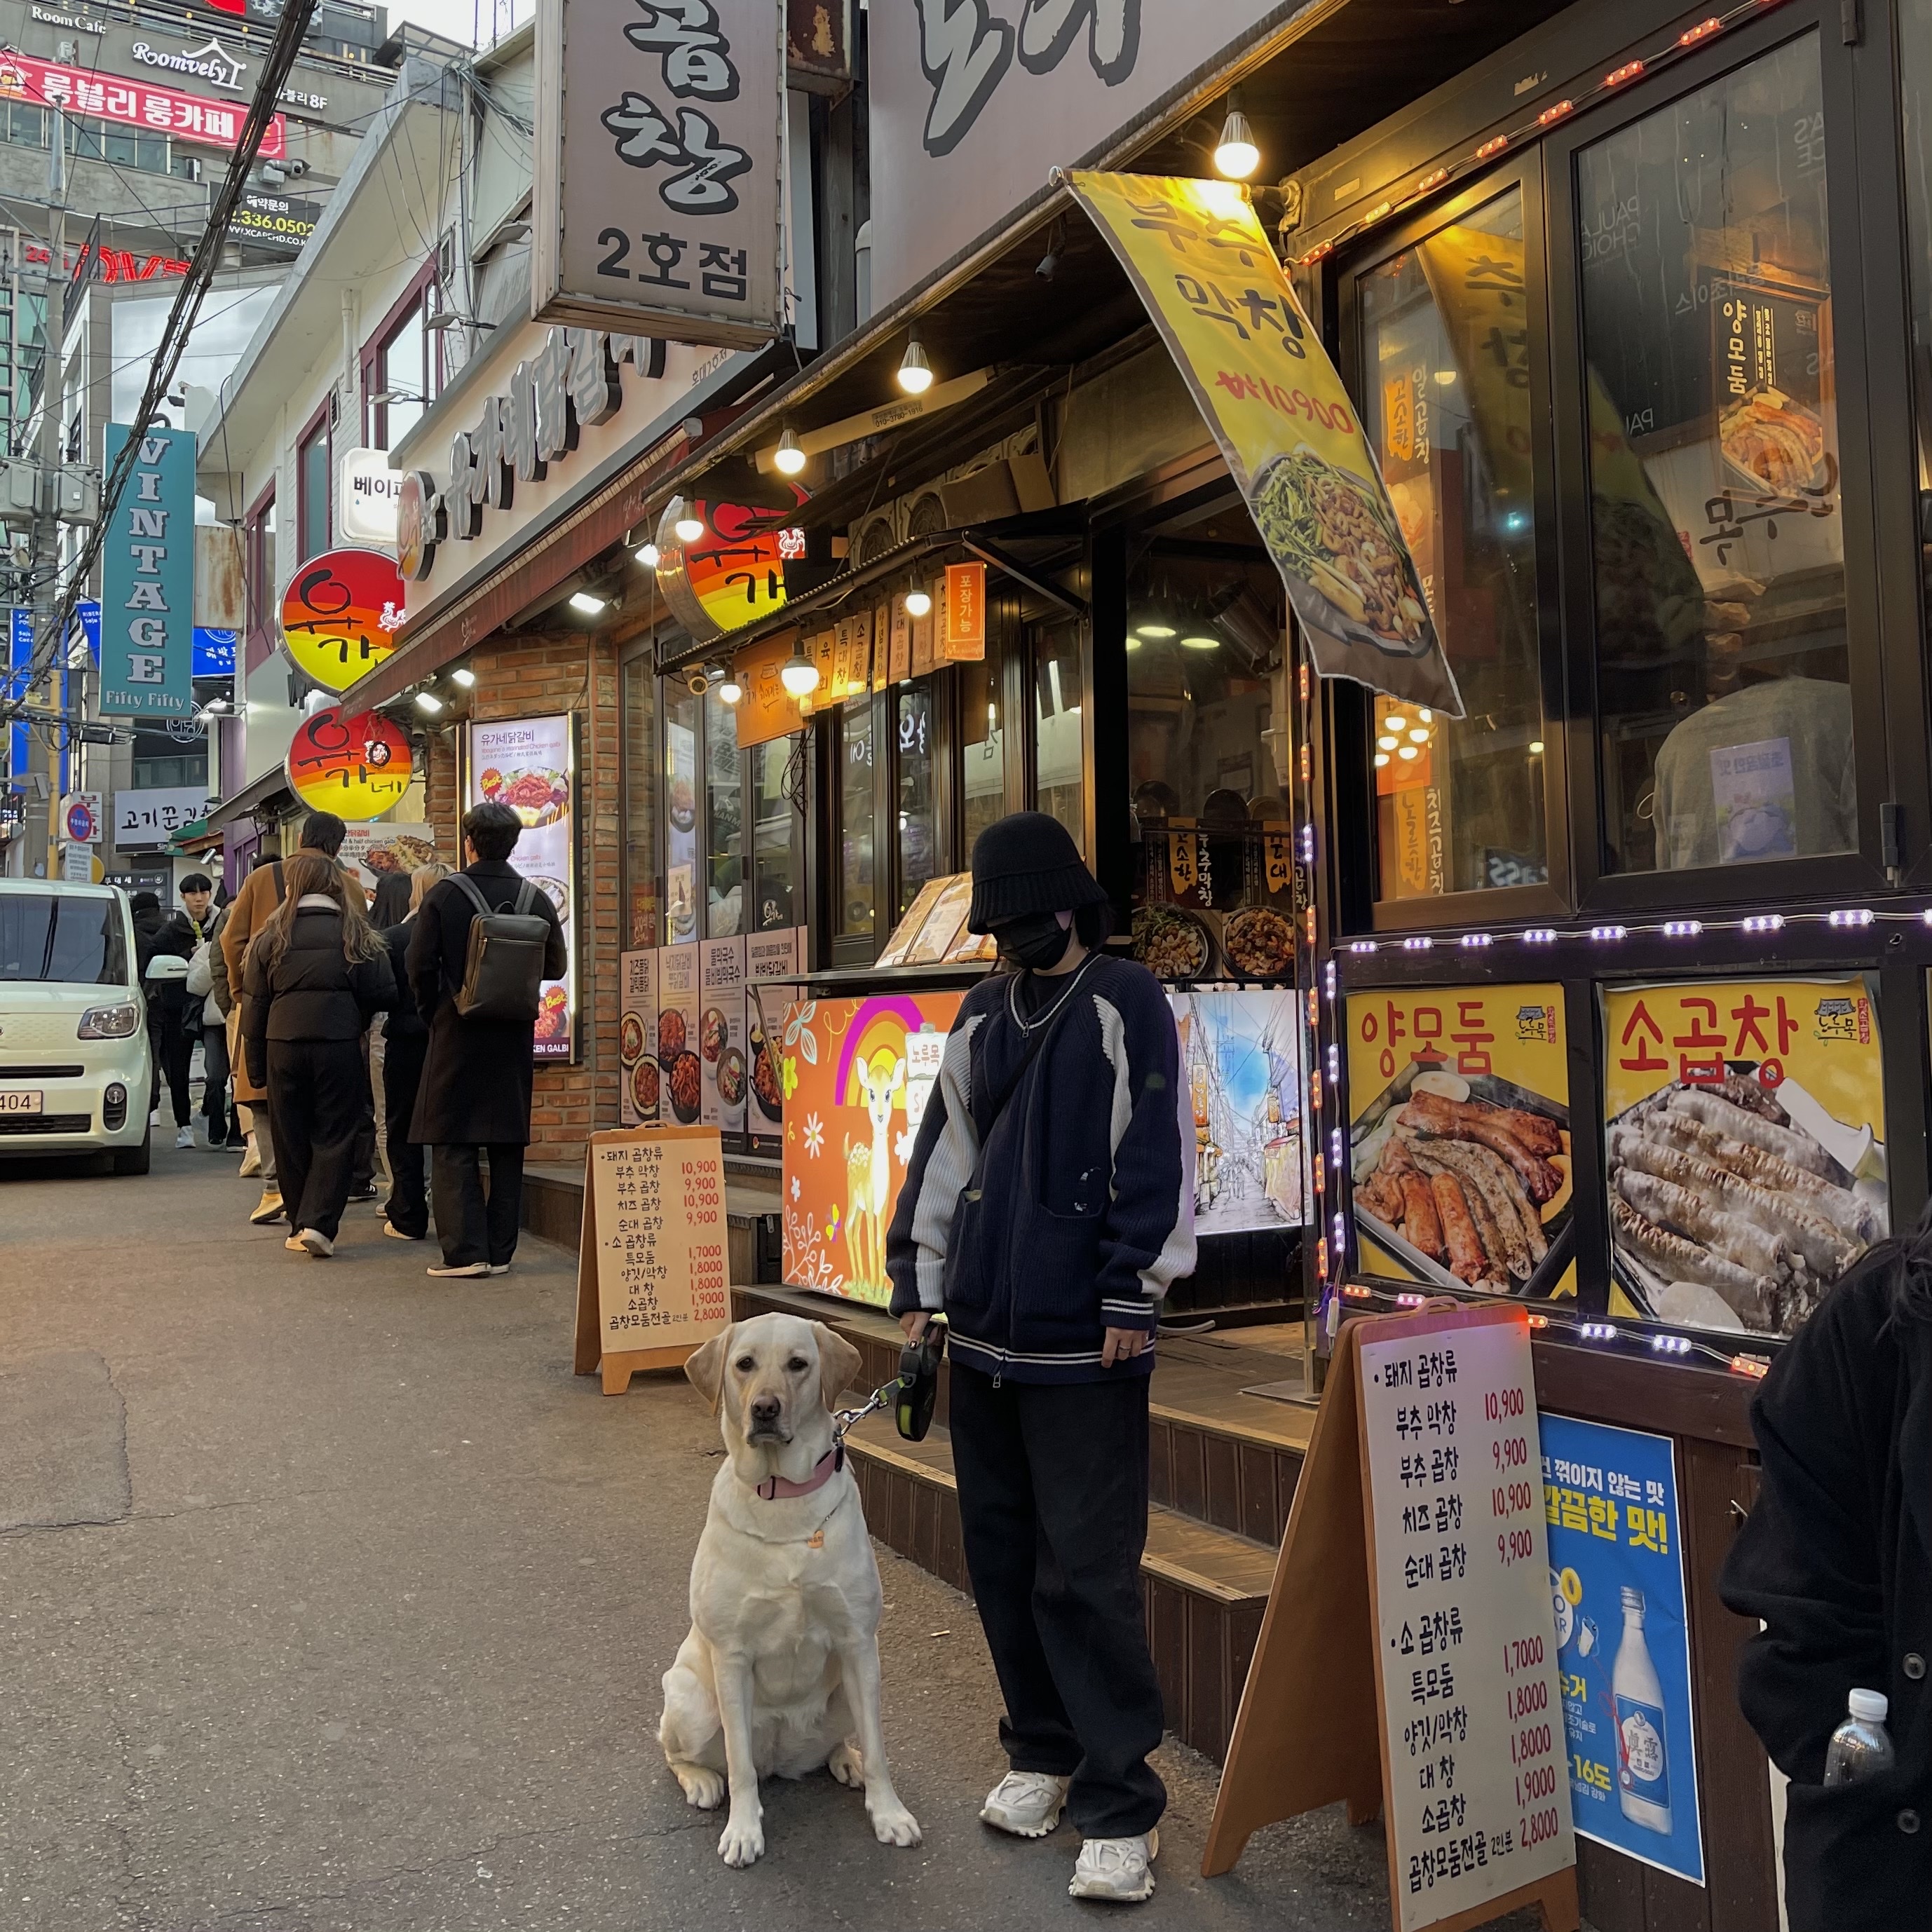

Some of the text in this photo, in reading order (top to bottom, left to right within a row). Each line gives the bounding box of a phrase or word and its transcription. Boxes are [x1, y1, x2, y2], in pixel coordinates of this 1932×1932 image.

[32, 6, 72, 27] Room
[132, 41, 227, 82] Roomvely
[41, 72, 234, 140] 룸블리 룸카페
[309, 94, 327, 110] 8F
[246, 194, 289, 214] 예약문의
[1124, 197, 1267, 268] 부추
[597, 227, 747, 301] 2호점
[1174, 274, 1306, 360] 막창
[1723, 299, 1747, 394] 양모둠
[124, 437, 172, 683] VINTAGE
[960, 575, 972, 633] 포장가능
[817, 641, 831, 691] 육회
[837, 630, 849, 684] 특대창
[853, 623, 865, 678] 소곱창
[106, 691, 185, 711] Fifty Fifty
[481, 730, 534, 747] 유가네닭갈비
[482, 775, 502, 790] Best
[1427, 789, 1445, 894] 치즈곱창
[711, 947, 735, 967] 물막국수
[545, 992, 566, 1009] Best
[547, 1044, 569, 1052] GALBI
[912, 1045, 939, 1066] 노루목
[1361, 1000, 1495, 1078] 양모둠
[1620, 993, 1799, 1089] 소곱창
[607, 1147, 663, 1162] 돼지 곱창류
[615, 1160, 717, 1178] 부추 막창 10,900
[617, 1177, 716, 1196] 부추 곱창 9,900
[618, 1193, 719, 1211] 치즈 곱창 10,900
[612, 1233, 657, 1249] 소 곱창류
[618, 1211, 717, 1232] 순대 곱창 9,900
[625, 1244, 721, 1265] 특모둠 1,7000
[689, 1260, 723, 1277] 1,8000
[628, 1291, 724, 1311] 소곱창 1,9000
[690, 1276, 723, 1291] 1,8000
[609, 1311, 672, 1330] 곱창모둠전골
[693, 1306, 726, 1323] 2,8000
[1385, 1350, 1457, 1389] 돼지 곱창류
[1396, 1388, 1524, 1440] 부추 막창 10,900
[1401, 1437, 1527, 1488] 부추 곱창 9,900
[1554, 1459, 1603, 1491] 꺾이지
[1608, 1471, 1641, 1501] 않는
[1646, 1480, 1664, 1506] 맛
[1403, 1481, 1531, 1534] 치즈 곱창 10,900
[1626, 1505, 1668, 1555] 맛!
[1405, 1529, 1532, 1589] 순대 곱창 9,900
[1401, 1607, 1463, 1655] 소 곱창류
[1411, 1635, 1543, 1705] 특모둠 1,7000
[1404, 1680, 1547, 1756] 양깃/막창 1,8000
[1511, 1723, 1551, 1767] 1,8000
[1574, 1754, 1612, 1791] 16도
[1422, 1764, 1556, 1835] 소곱창 1,9000
[1409, 1807, 1558, 1893] 곱창모둠전골 2인분 2,8000
